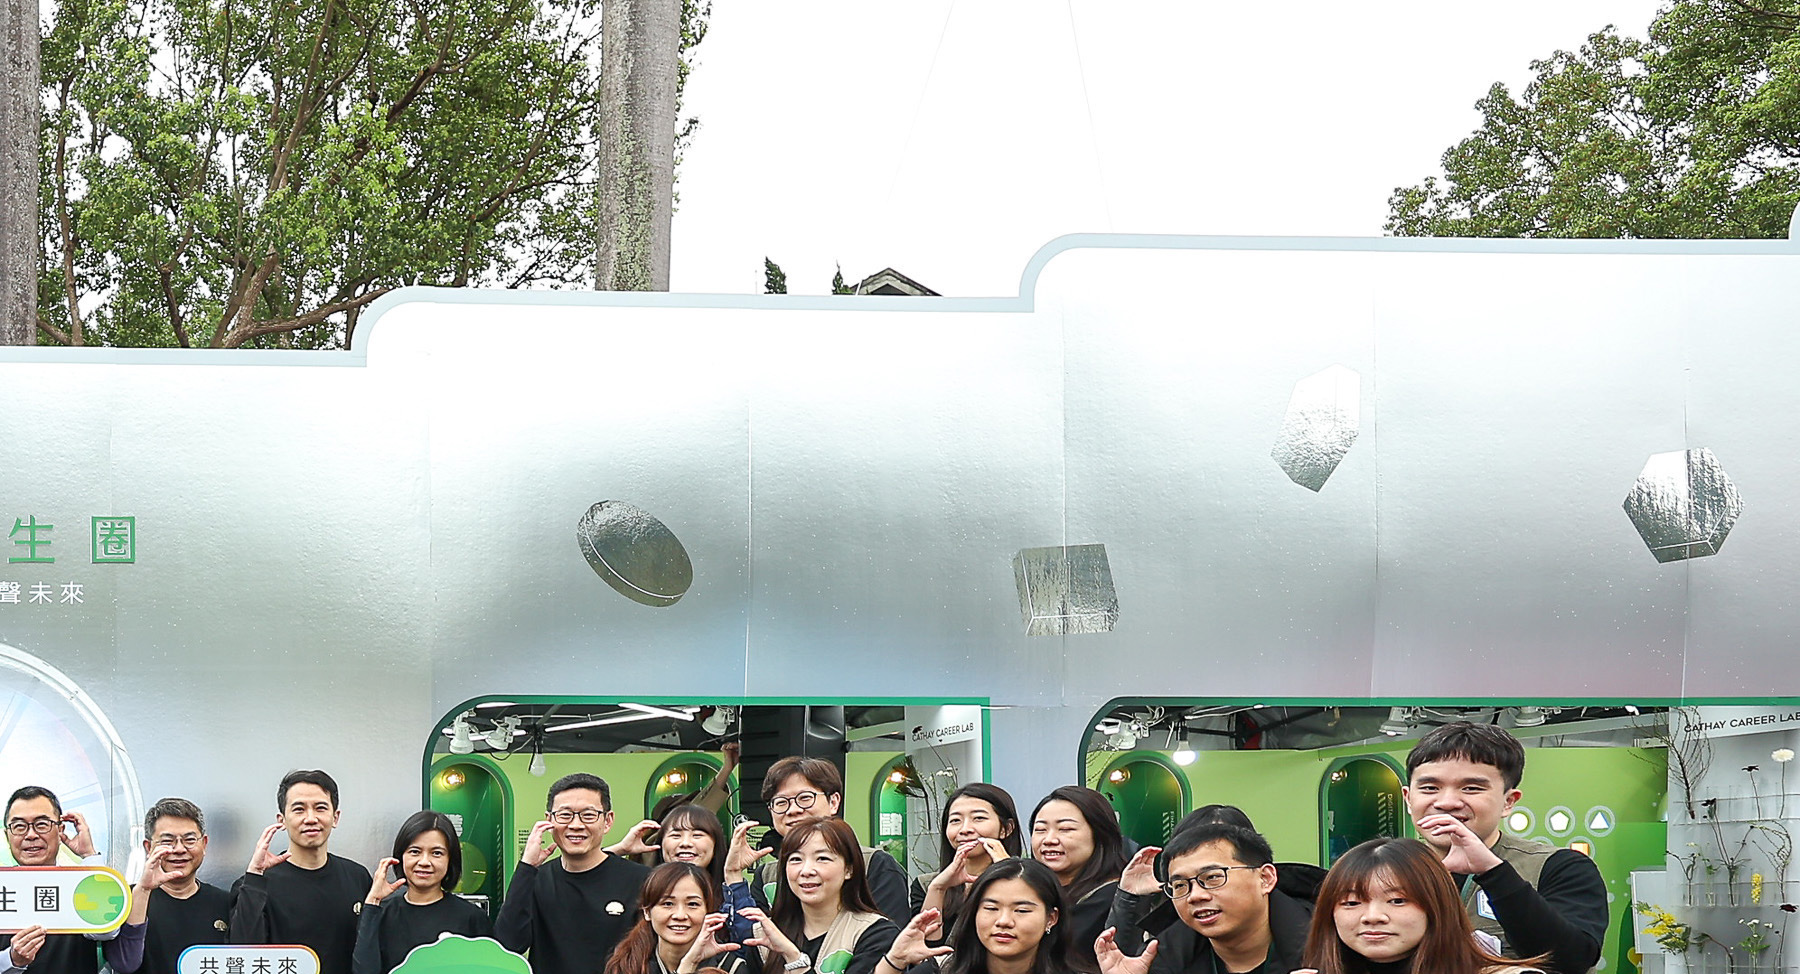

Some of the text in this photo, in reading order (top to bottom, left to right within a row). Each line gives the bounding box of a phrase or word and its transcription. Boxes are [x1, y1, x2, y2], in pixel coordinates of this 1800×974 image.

[912, 723, 974, 742] CATHAY CAREER LAB
[1684, 720, 1726, 733] CATHAY
[1730, 715, 1776, 728] CAREER
[199, 956, 297, 974] 共聲未來
